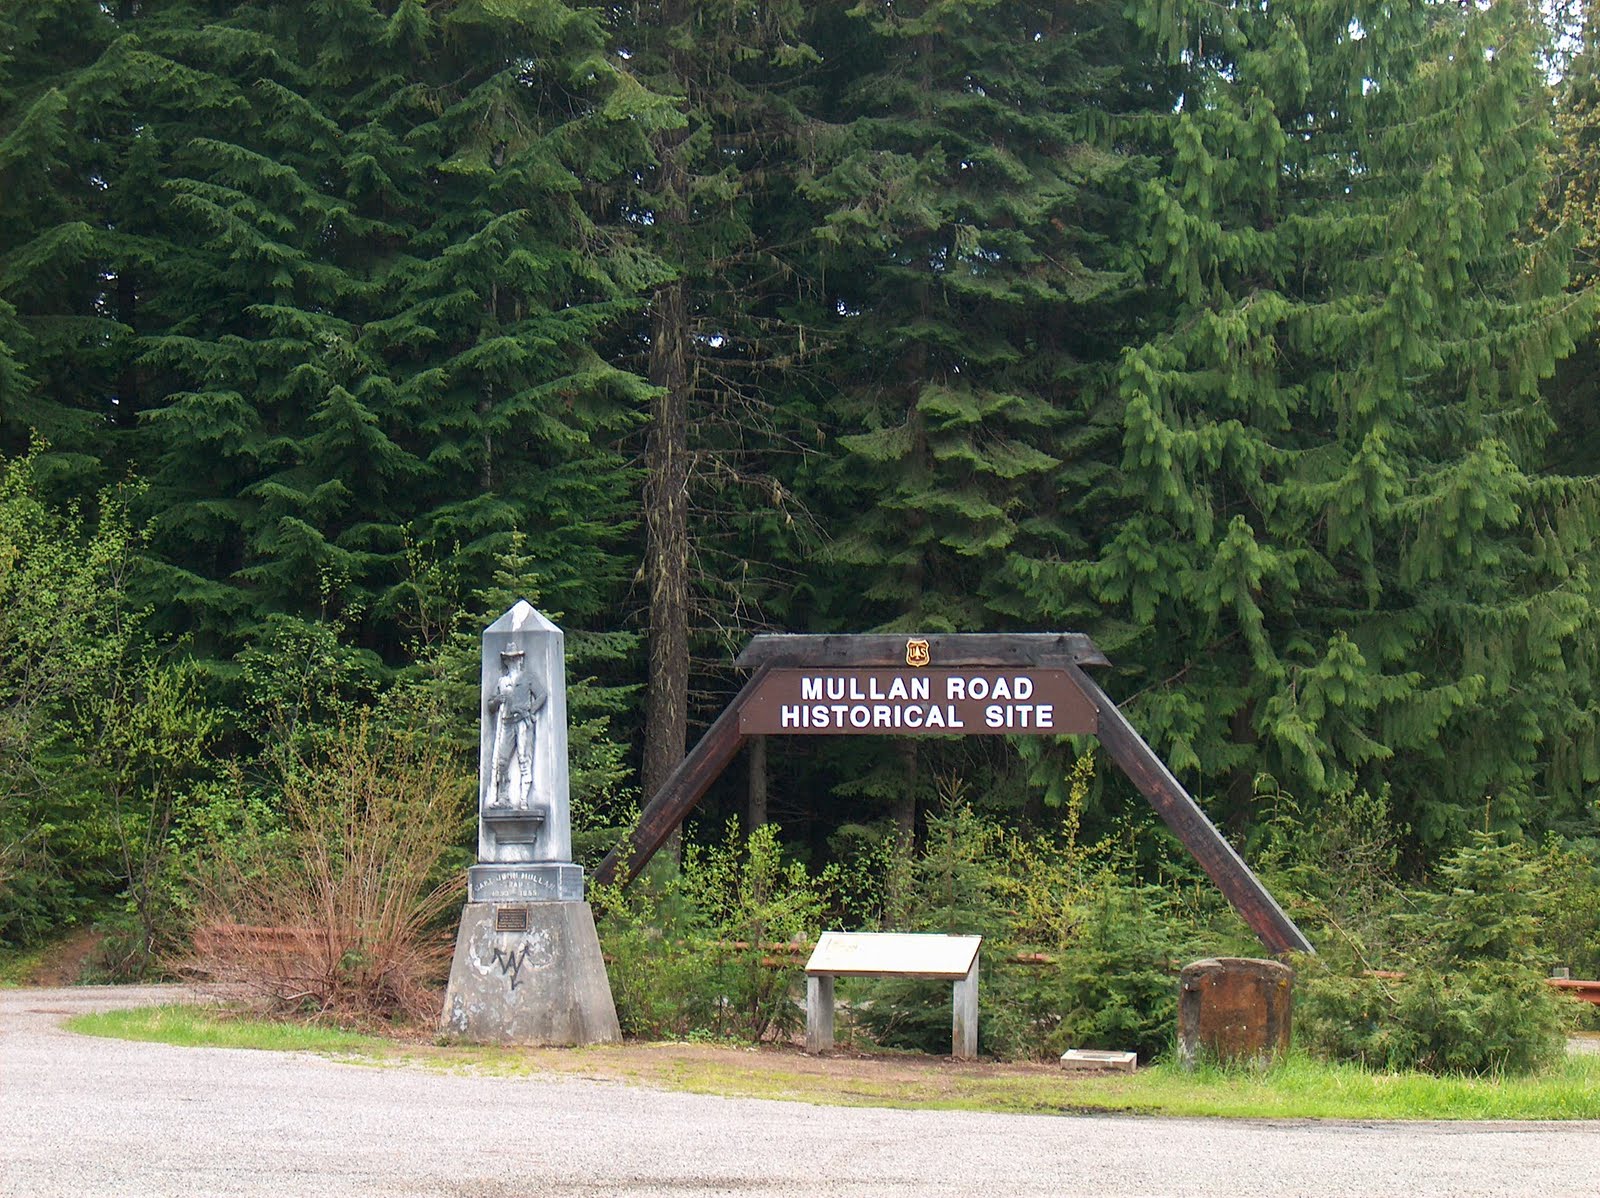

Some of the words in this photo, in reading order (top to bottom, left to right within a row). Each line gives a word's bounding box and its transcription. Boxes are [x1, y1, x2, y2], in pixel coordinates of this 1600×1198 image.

[801, 676, 930, 700] MULLAN
[946, 676, 1034, 700] ROAD
[780, 704, 964, 728] HISTORICAL
[984, 704, 1054, 728] SITE
